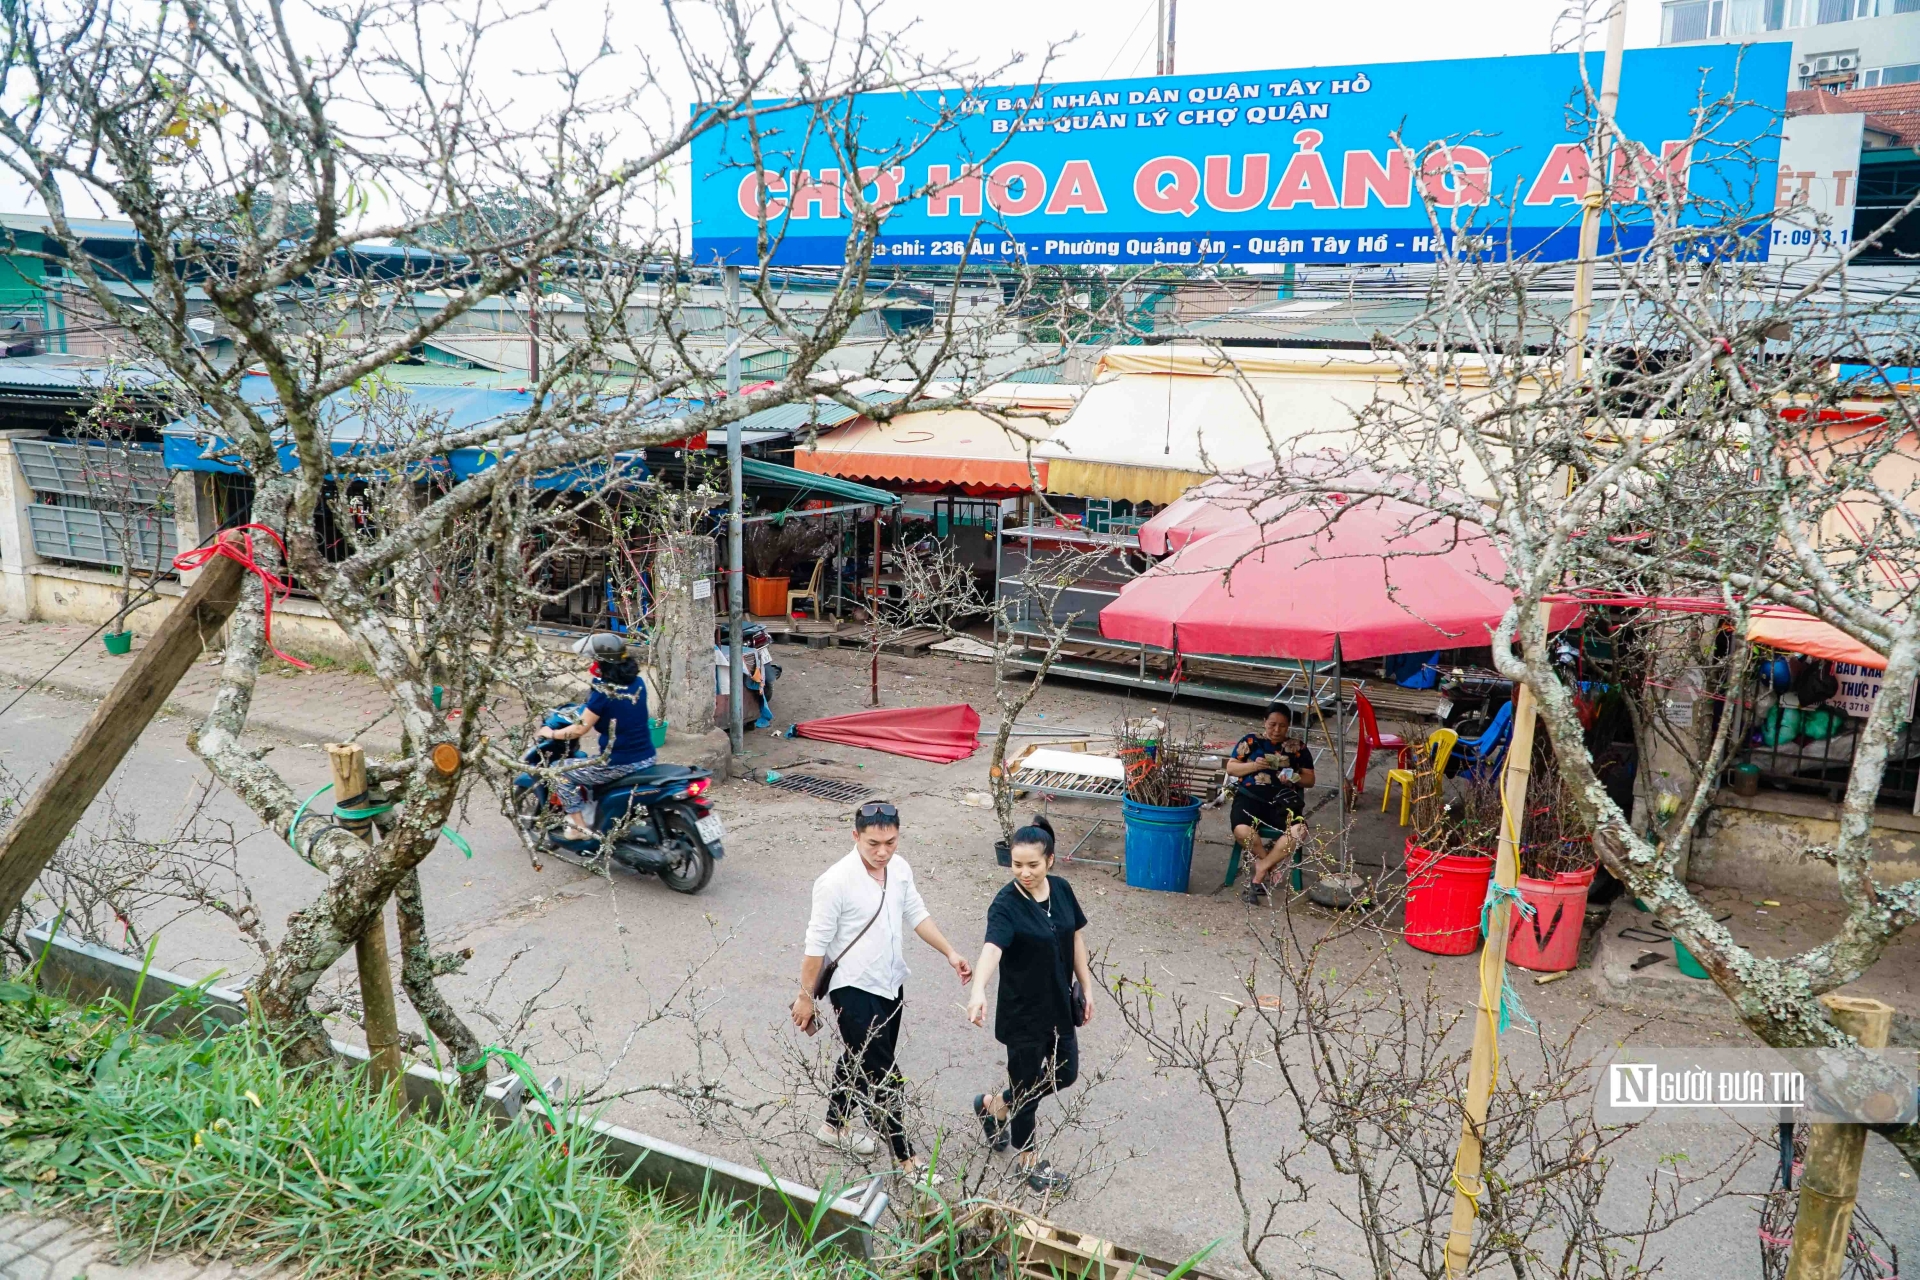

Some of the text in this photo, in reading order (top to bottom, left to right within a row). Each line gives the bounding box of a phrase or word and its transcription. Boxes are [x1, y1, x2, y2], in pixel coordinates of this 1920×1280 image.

[996, 97, 1044, 111] BAN
[1052, 90, 1119, 108] NHÂN
[1128, 88, 1180, 104] DÂN
[1188, 82, 1260, 104] QUẬN
[1268, 79, 1322, 97] TÂY
[1331, 72, 1371, 94] HỒ
[991, 101, 1329, 133] BAN QUẢN LÝ CHỢ QUẬN
[738, 128, 1693, 232] CHỢ HOA QUẢNG AN
[891, 239, 925, 256] chỉ:
[930, 241, 965, 256] 236
[969, 237, 995, 256] Âu
[1044, 239, 1120, 256] Phường
[1126, 237, 1191, 256] Quảng
[1248, 236, 1304, 256] Quận
[1311, 235, 1351, 256] Tây
[1357, 233, 1388, 253] Hồ
